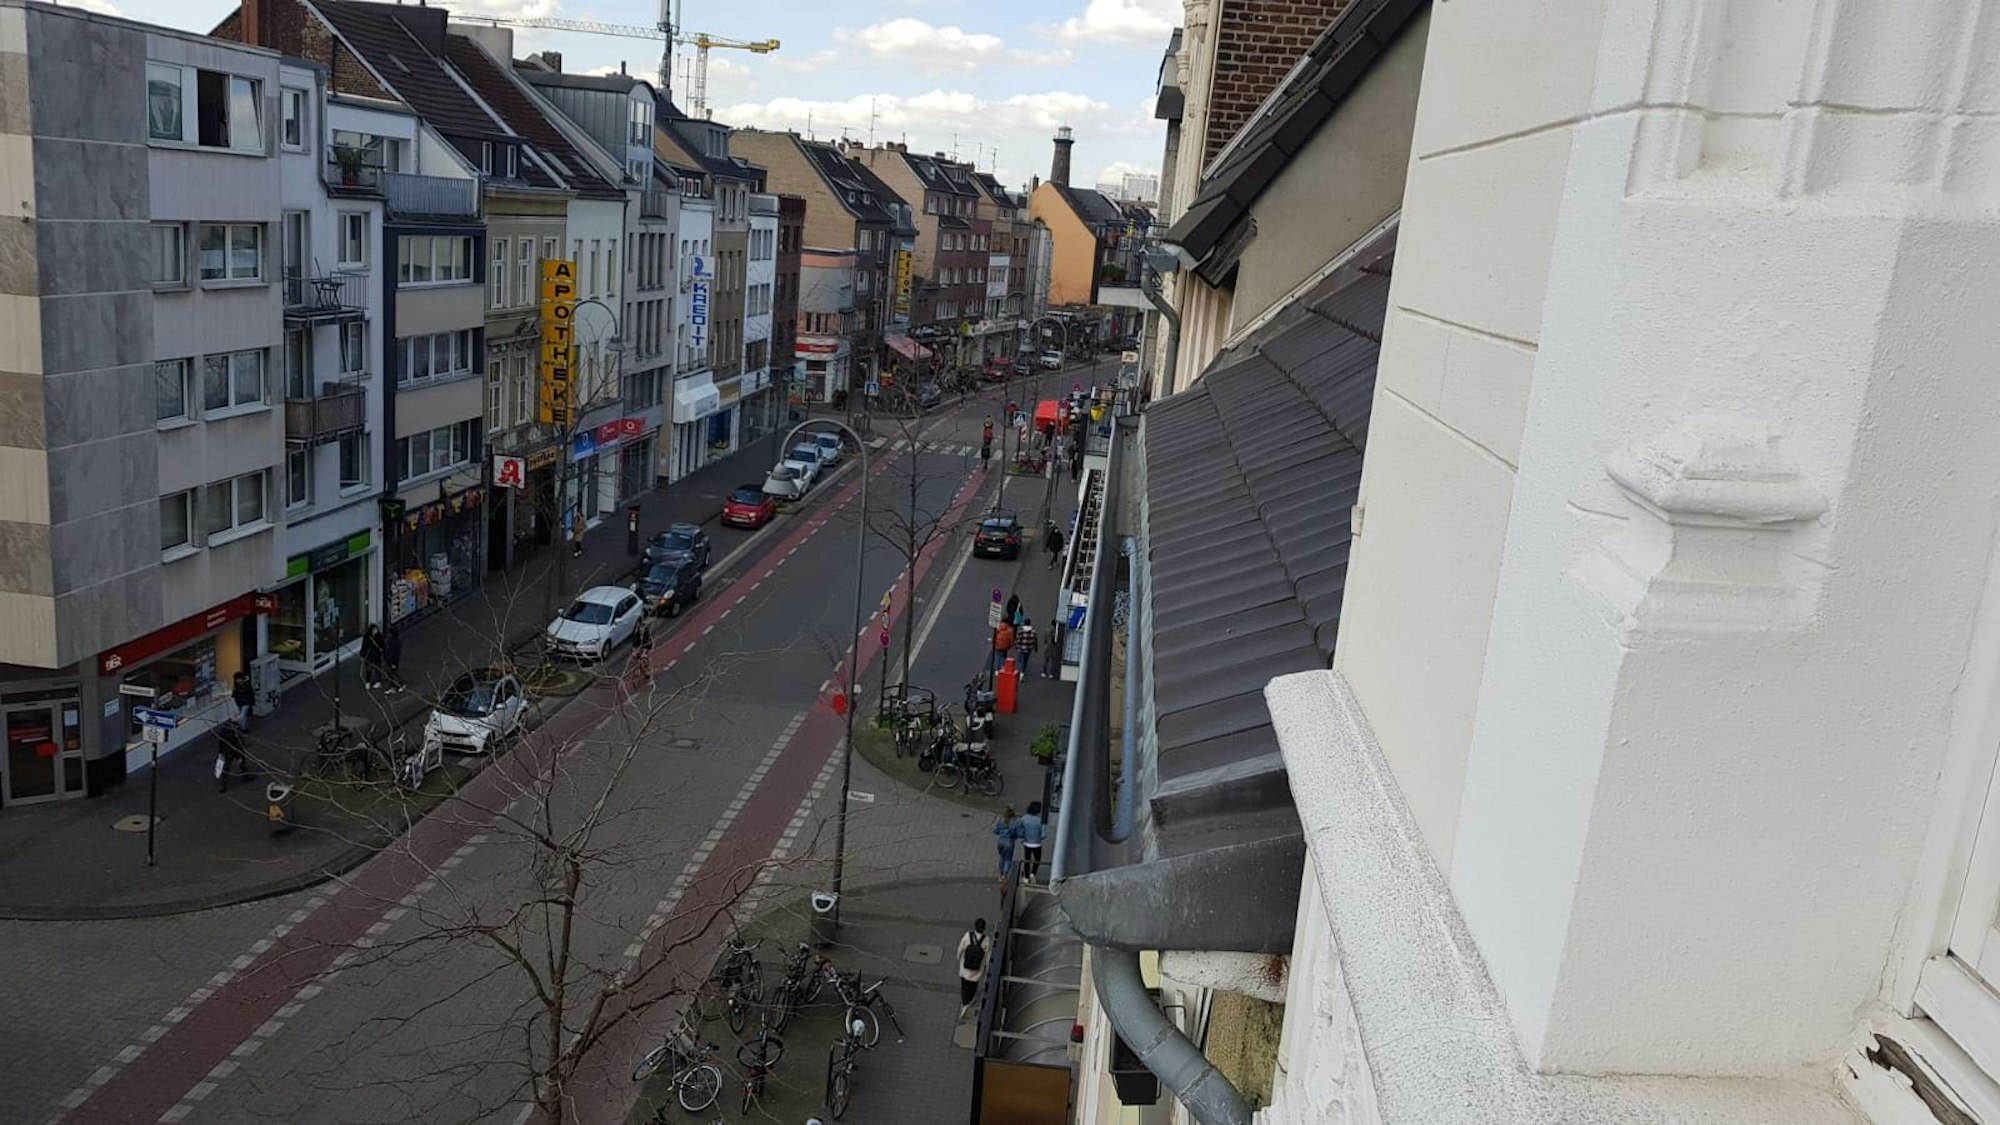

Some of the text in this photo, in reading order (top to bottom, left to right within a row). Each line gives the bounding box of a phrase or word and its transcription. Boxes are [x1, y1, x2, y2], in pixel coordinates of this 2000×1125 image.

[552, 263, 571, 421] APOTHEKE
[691, 283, 707, 346] KREDIT
[498, 459, 521, 483] A
